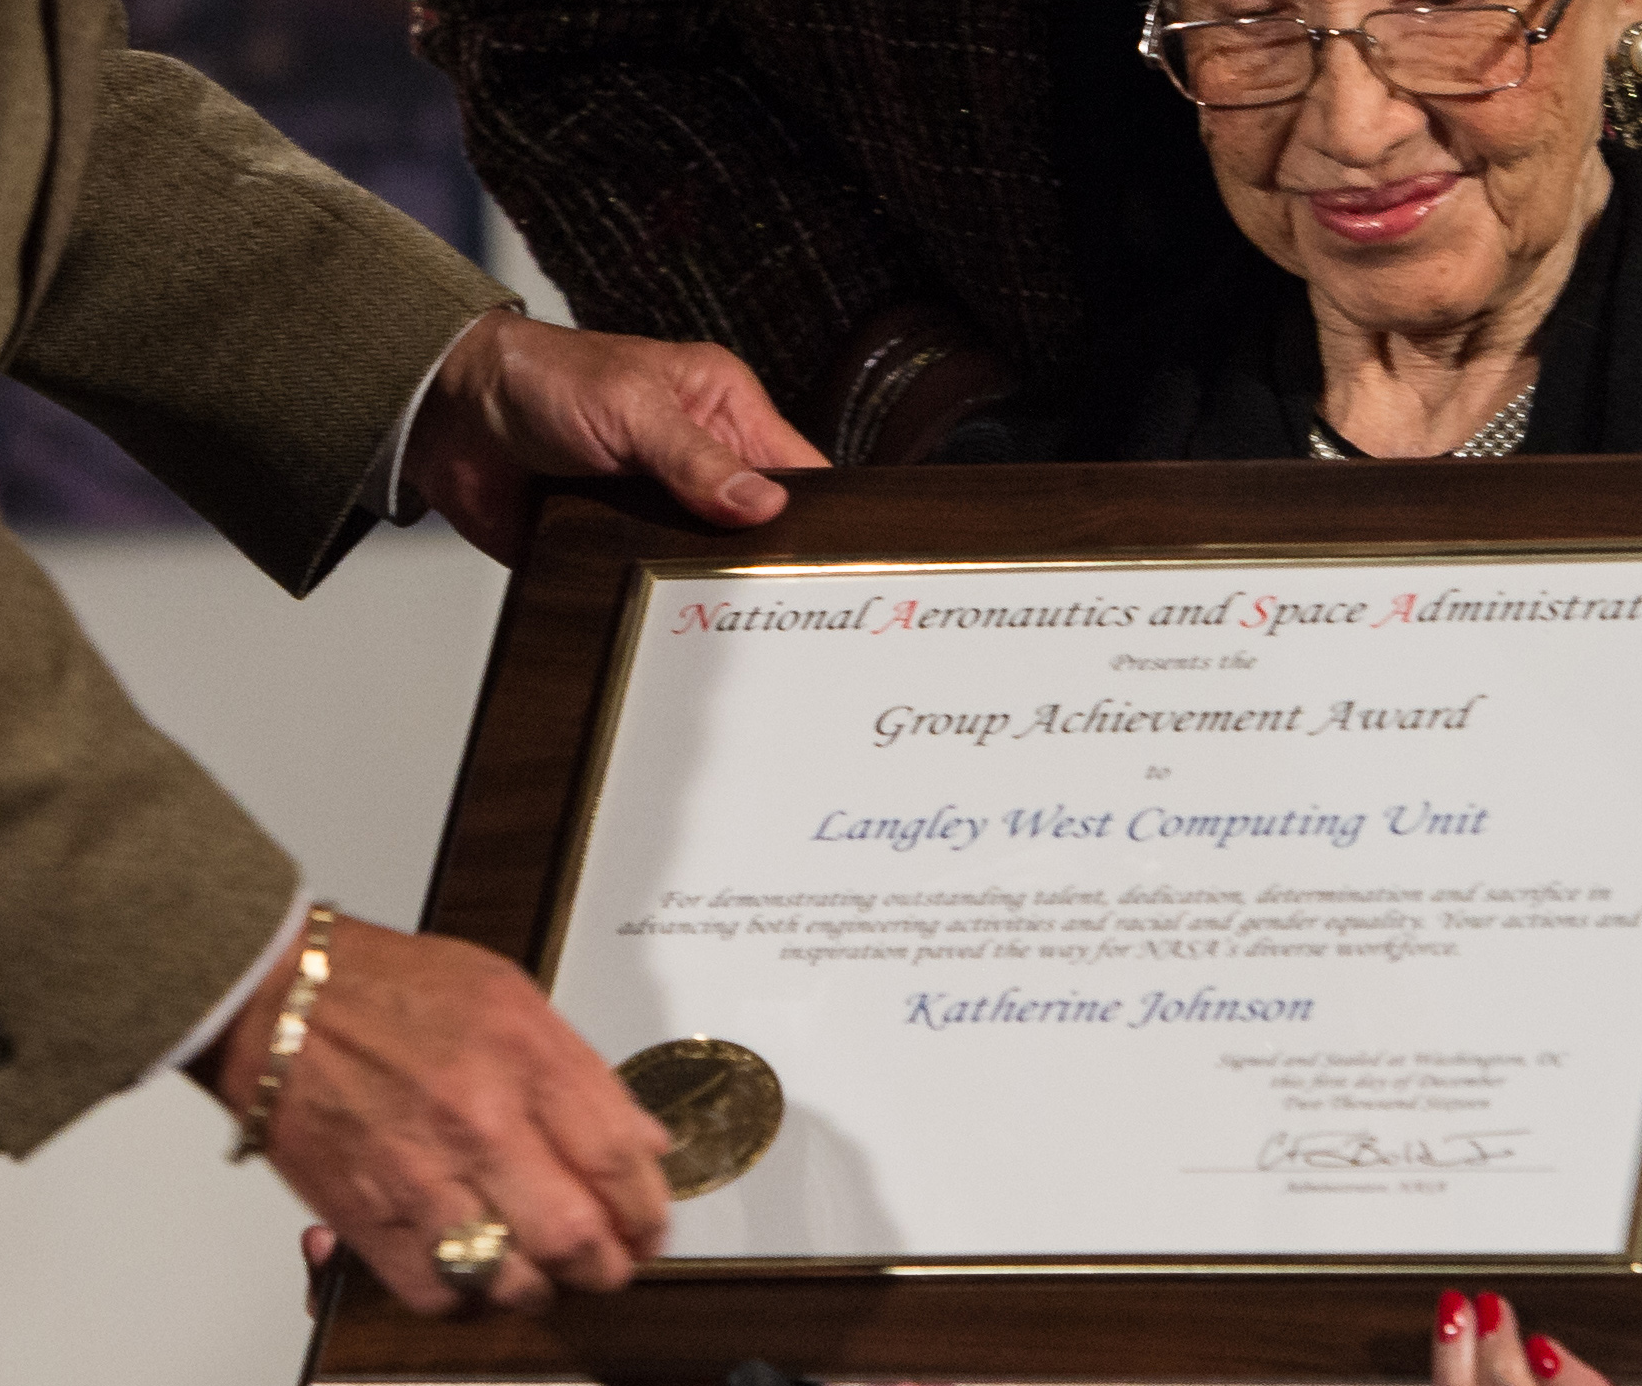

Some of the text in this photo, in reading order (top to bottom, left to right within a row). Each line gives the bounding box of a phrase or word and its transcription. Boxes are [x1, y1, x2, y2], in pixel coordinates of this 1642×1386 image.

[672, 597, 882, 635] National
[870, 596, 1134, 635] Aeronautics
[1148, 590, 1246, 627] and
[1239, 594, 1367, 636] Space
[1110, 649, 1257, 672] Presents the
[874, 694, 1488, 748] Group Achievement Award
[1144, 764, 1171, 780] to
[809, 800, 1490, 852] Langley West Computing Unit
[659, 889, 702, 909] For
[708, 888, 877, 913] demonstrating
[882, 885, 1027, 912] outstanding
[1033, 884, 1109, 909] talent,
[1256, 883, 1424, 904] determination
[1430, 881, 1485, 903] and
[1485, 881, 1581, 908] sacrifice
[1586, 884, 1613, 902] in
[616, 915, 739, 940] advancing
[745, 913, 798, 936] both
[805, 916, 940, 939] engineering
[945, 912, 1054, 935] activities
[1061, 910, 1113, 933] and
[1115, 910, 1187, 932] racial
[1188, 909, 1240, 931] and
[1238, 910, 1321, 937] gender
[1440, 909, 1495, 930] Your
[1501, 908, 1587, 929] actions
[780, 941, 908, 966] inspiration
[913, 939, 990, 966] paved
[993, 939, 1032, 960] the
[1037, 942, 1088, 965] way
[1086, 937, 1131, 965] for
[1245, 936, 1328, 957] diverse
[906, 985, 1315, 1031] Katherine Johnson
